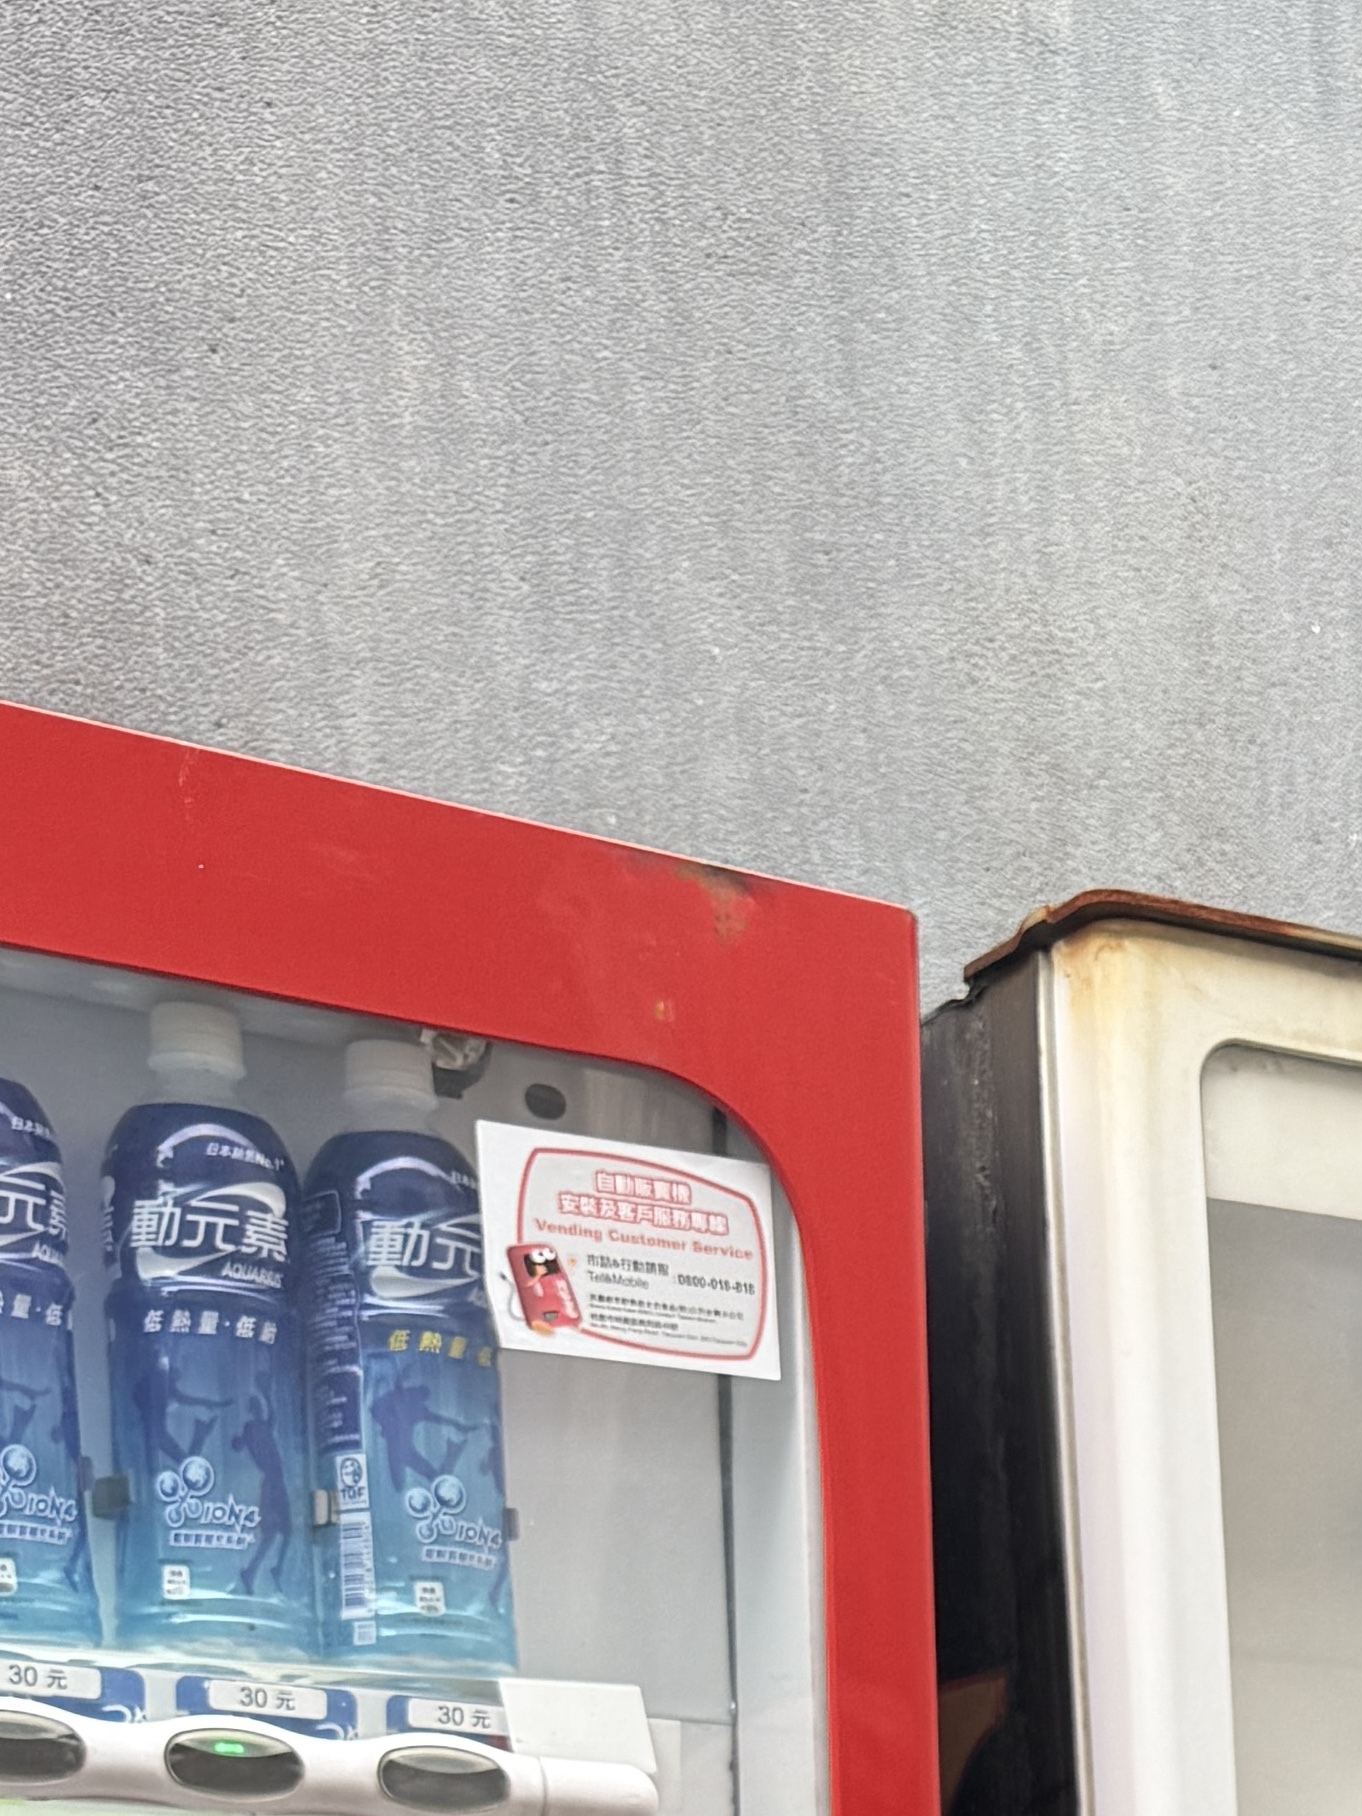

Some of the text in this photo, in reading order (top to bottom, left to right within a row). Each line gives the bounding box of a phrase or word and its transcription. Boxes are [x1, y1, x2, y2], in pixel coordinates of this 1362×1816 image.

[130, 1199, 290, 1262] 動元素
[533, 1217, 753, 1261] Vending Customer Service
[8, 1665, 68, 1690] 30 元
[239, 1686, 296, 1711] 30 元
[438, 1705, 492, 1729] 30 元
